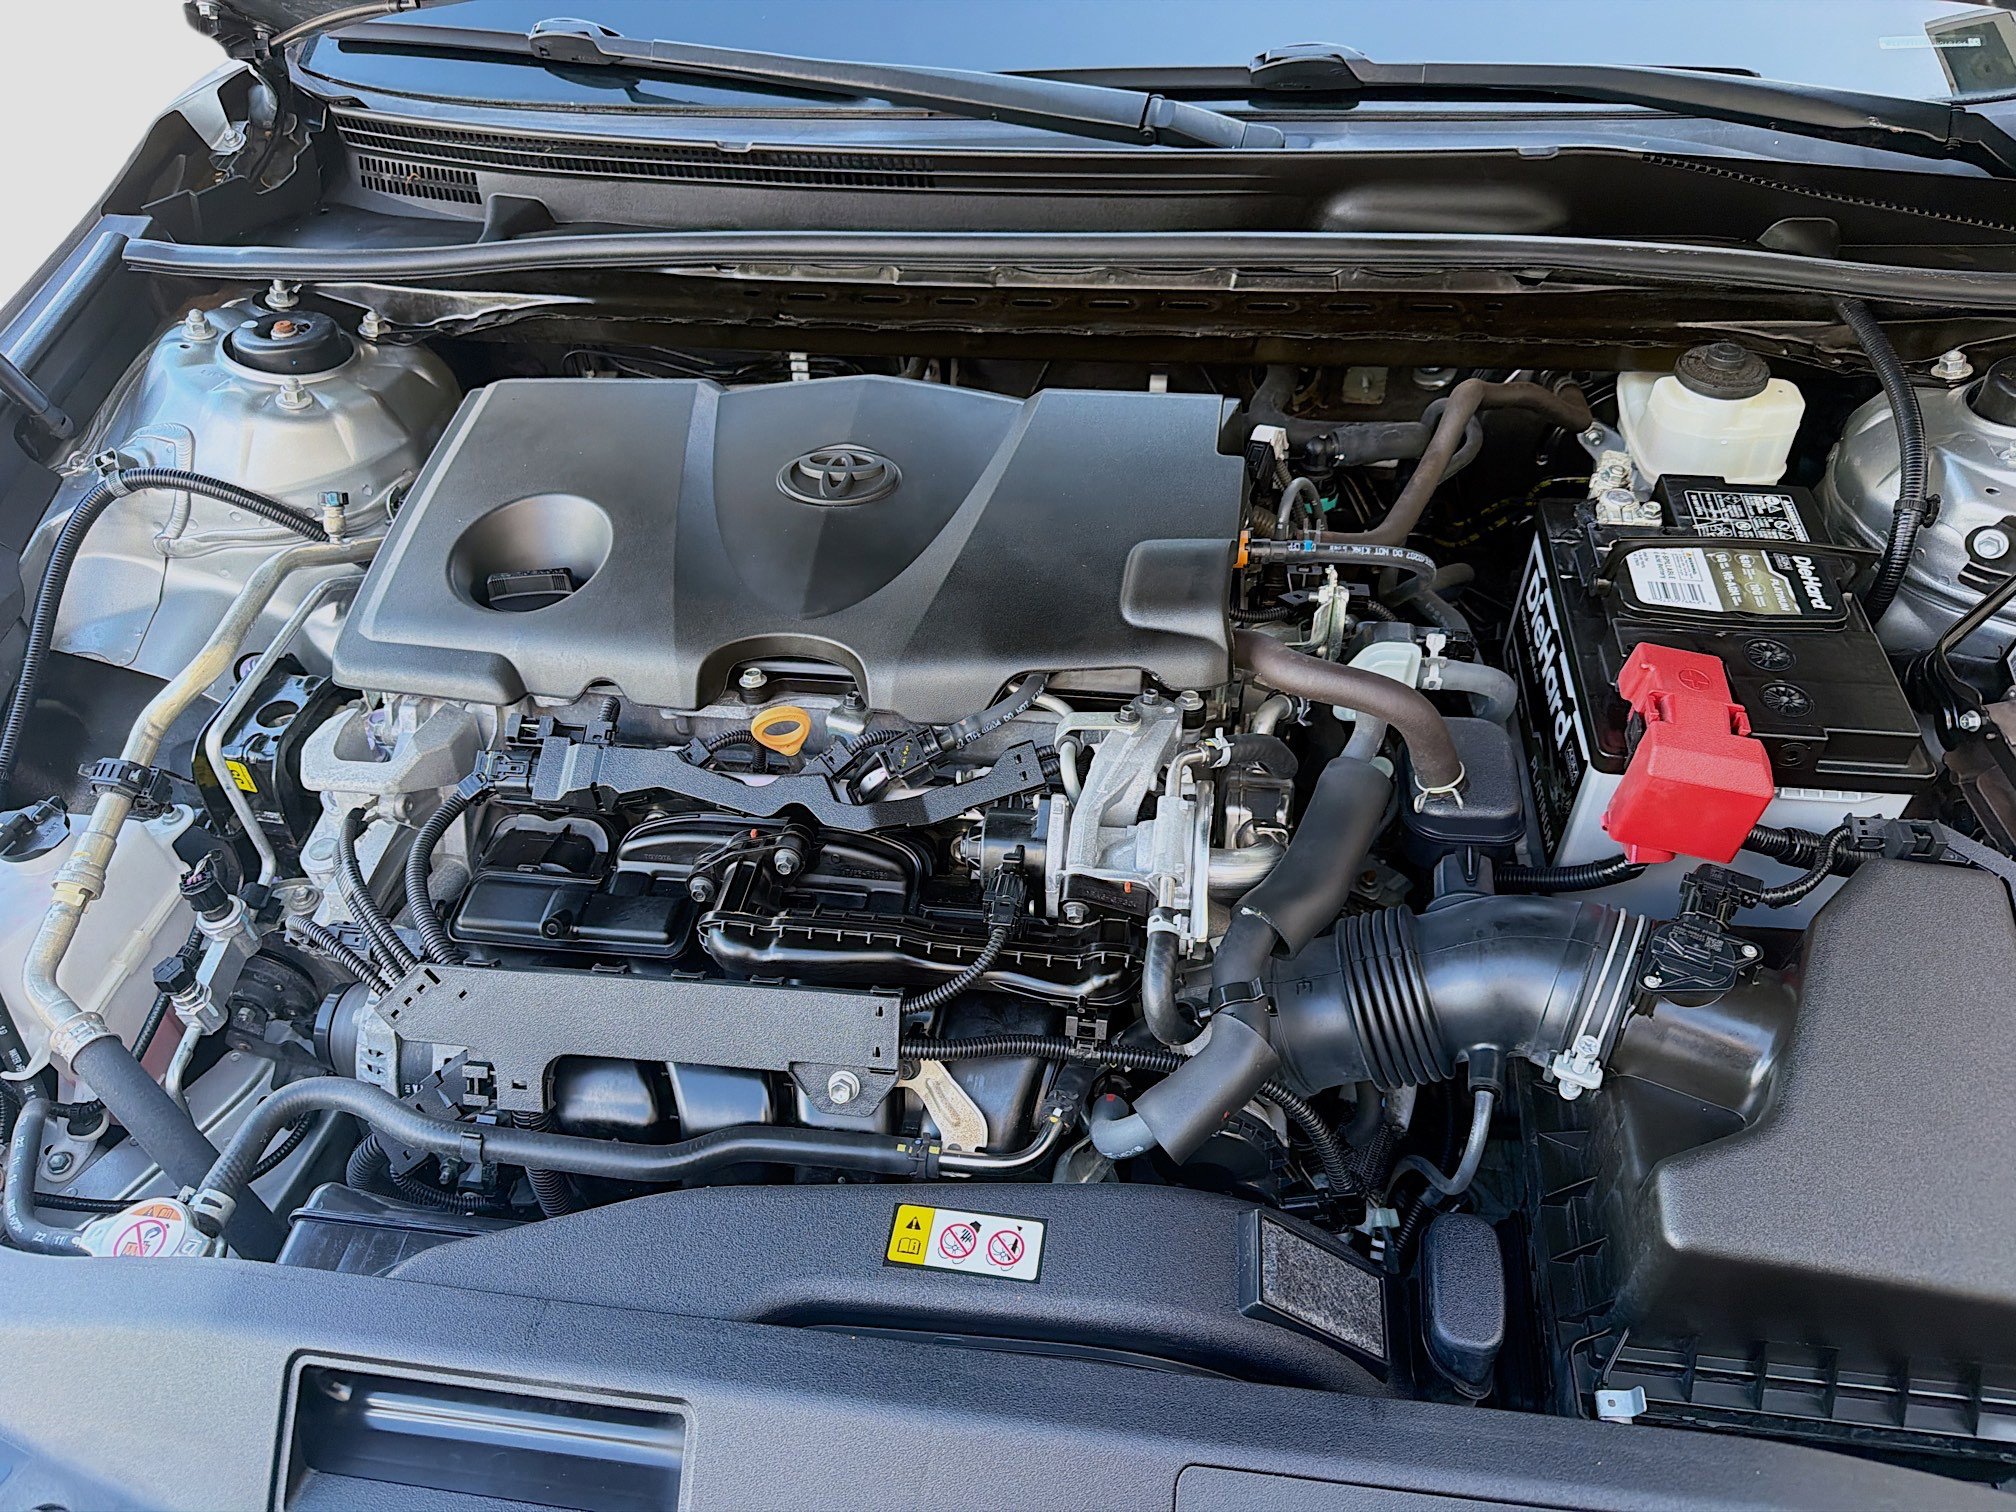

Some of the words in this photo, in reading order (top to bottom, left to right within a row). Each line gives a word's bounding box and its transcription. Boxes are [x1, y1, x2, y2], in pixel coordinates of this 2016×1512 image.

[1768, 578, 1791, 611] PLATINUM
[1792, 555, 1832, 611] DieHard
[1526, 567, 1572, 752] DieHard
[1529, 755, 1555, 856] PLATINUM
[643, 853, 672, 861] TOYOTA
[32, 1230, 47, 1243] 22
